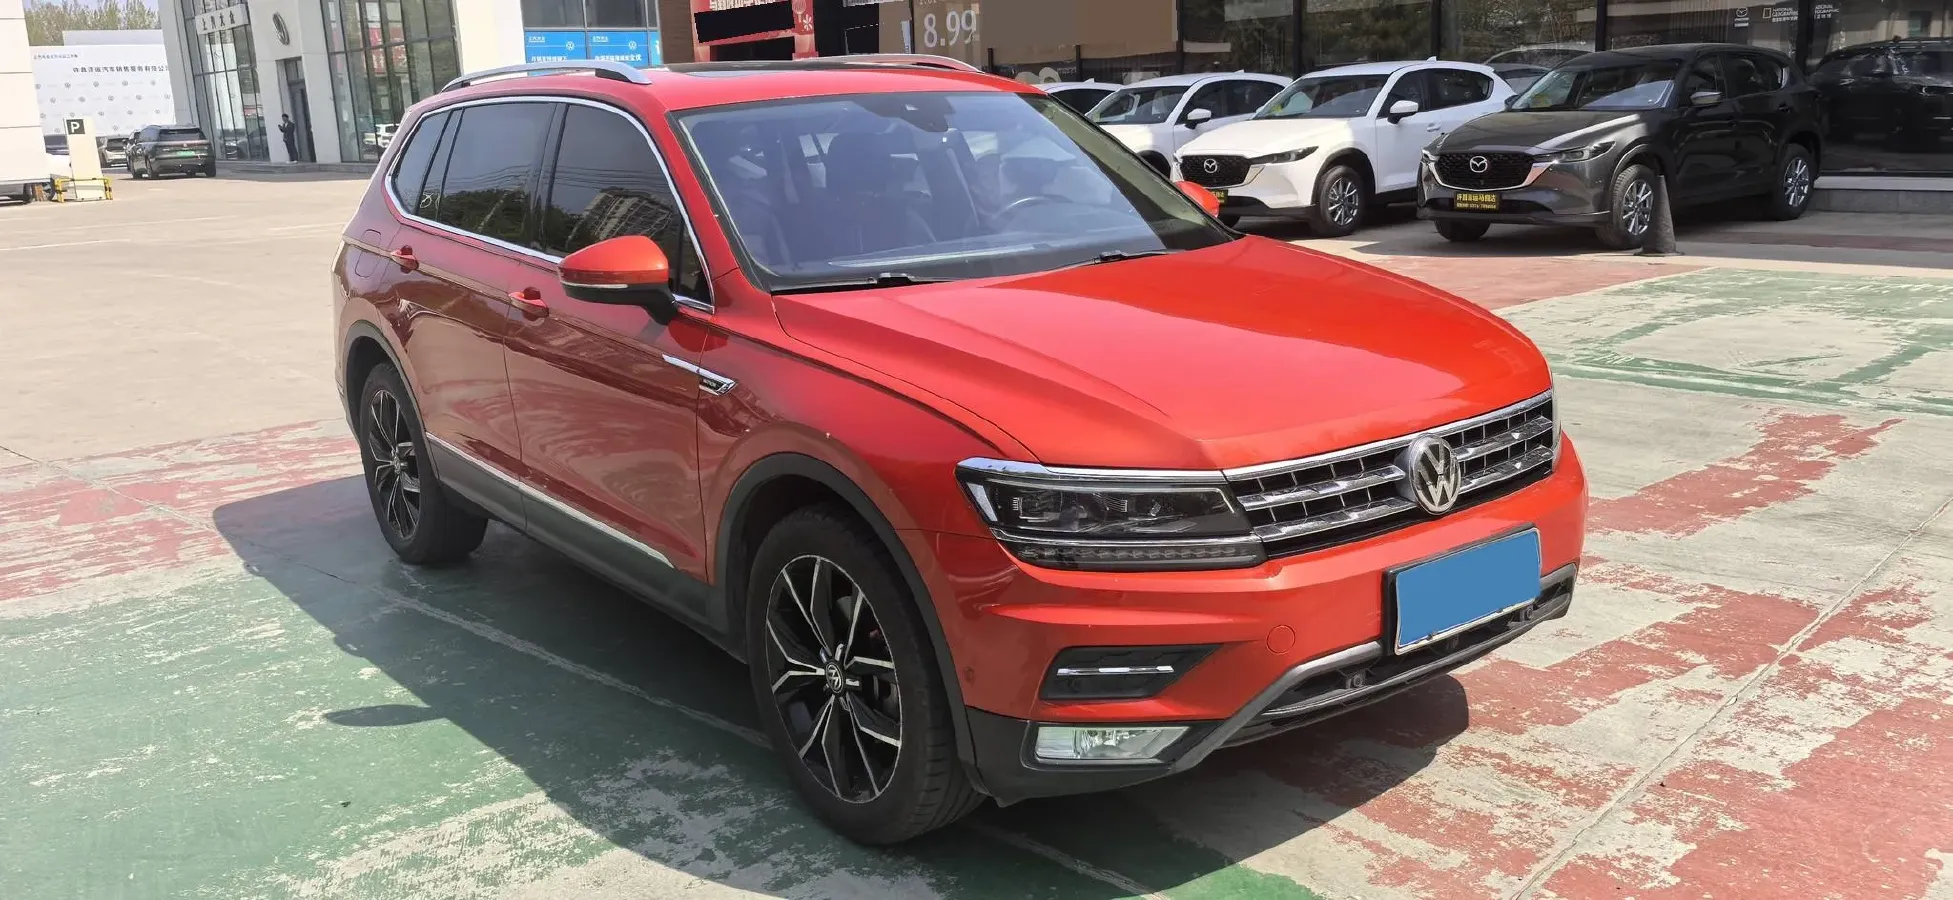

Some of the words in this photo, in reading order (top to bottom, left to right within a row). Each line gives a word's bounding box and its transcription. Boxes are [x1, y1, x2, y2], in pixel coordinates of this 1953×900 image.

[924, 10, 977, 48] 8.99
[70, 121, 80, 133] P
[1413, 438, 1458, 512] VW
